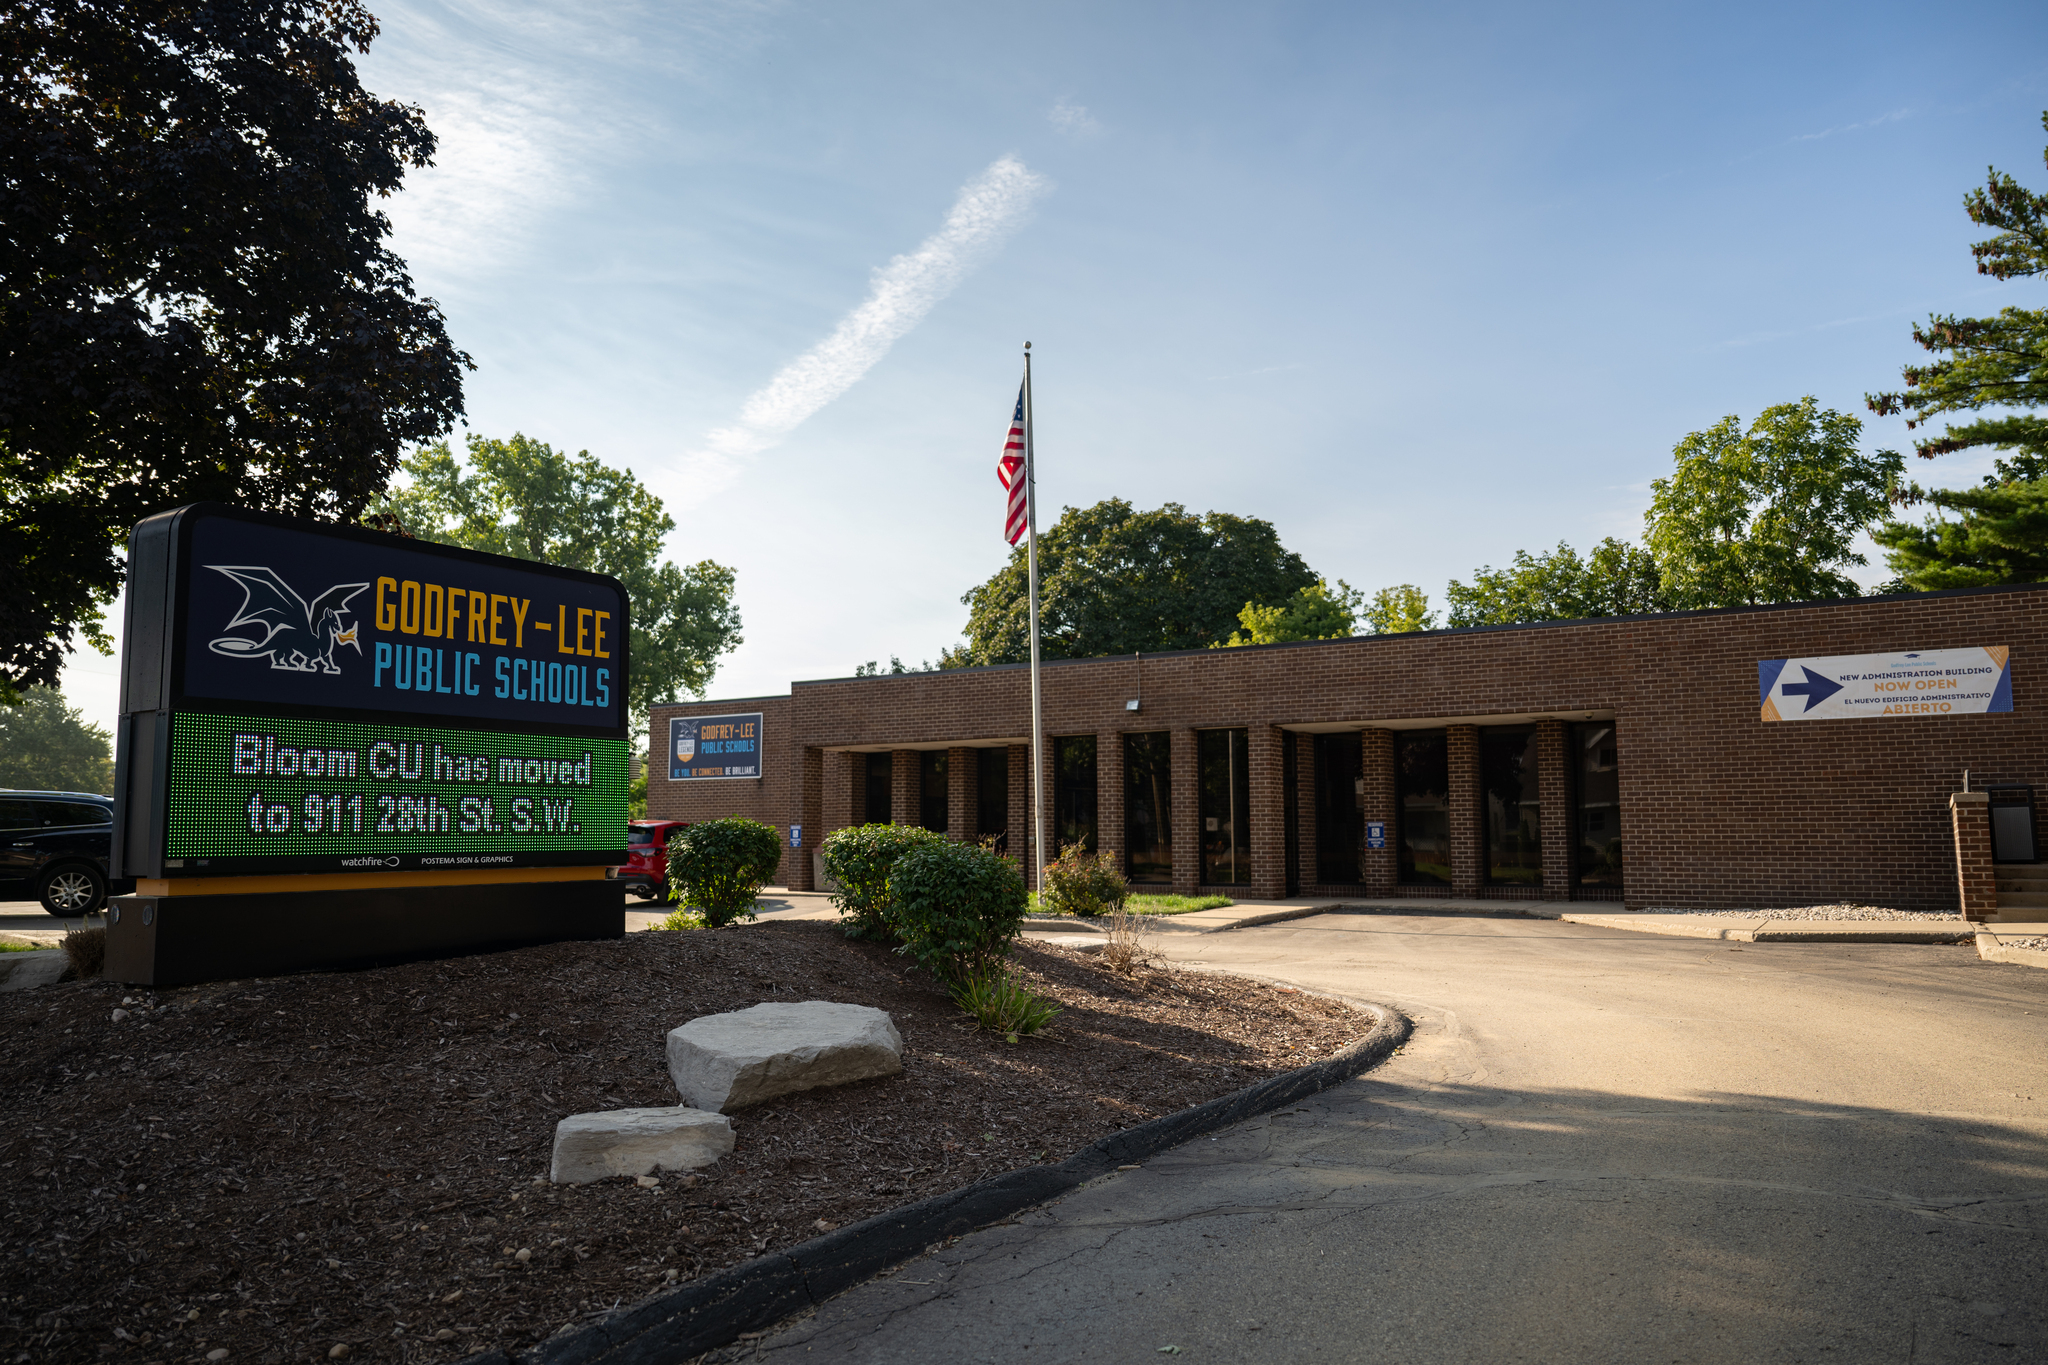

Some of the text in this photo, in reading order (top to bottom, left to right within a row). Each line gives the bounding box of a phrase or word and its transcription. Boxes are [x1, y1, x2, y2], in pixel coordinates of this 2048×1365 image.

[375, 576, 611, 659] GODFREY-LEE
[374, 641, 610, 708] PUBLIC SCHOOLS
[1840, 667, 1992, 682] NEW ADMINISTRATION BUILDING
[1874, 678, 1958, 693] NOW OPEN
[1882, 695, 1919, 703] EDIFICIO
[1921, 692, 1991, 701] ADMINISTRATIVO
[1883, 702, 1952, 715] ABIERTO
[701, 723, 755, 740] GODFREY-LEE
[701, 740, 755, 754] PUBLIC SCHOOLS
[233, 734, 591, 785] Bloom CU has moved
[674, 766, 756, 777] BE YOU. BE CONNECTED. BE BRILLIANT.
[248, 793, 580, 833] to 911 28th St. S.W.
[341, 856, 383, 867] watchfire
[421, 857, 455, 865] POSTEMA
[480, 855, 513, 863] GRAPHICS
